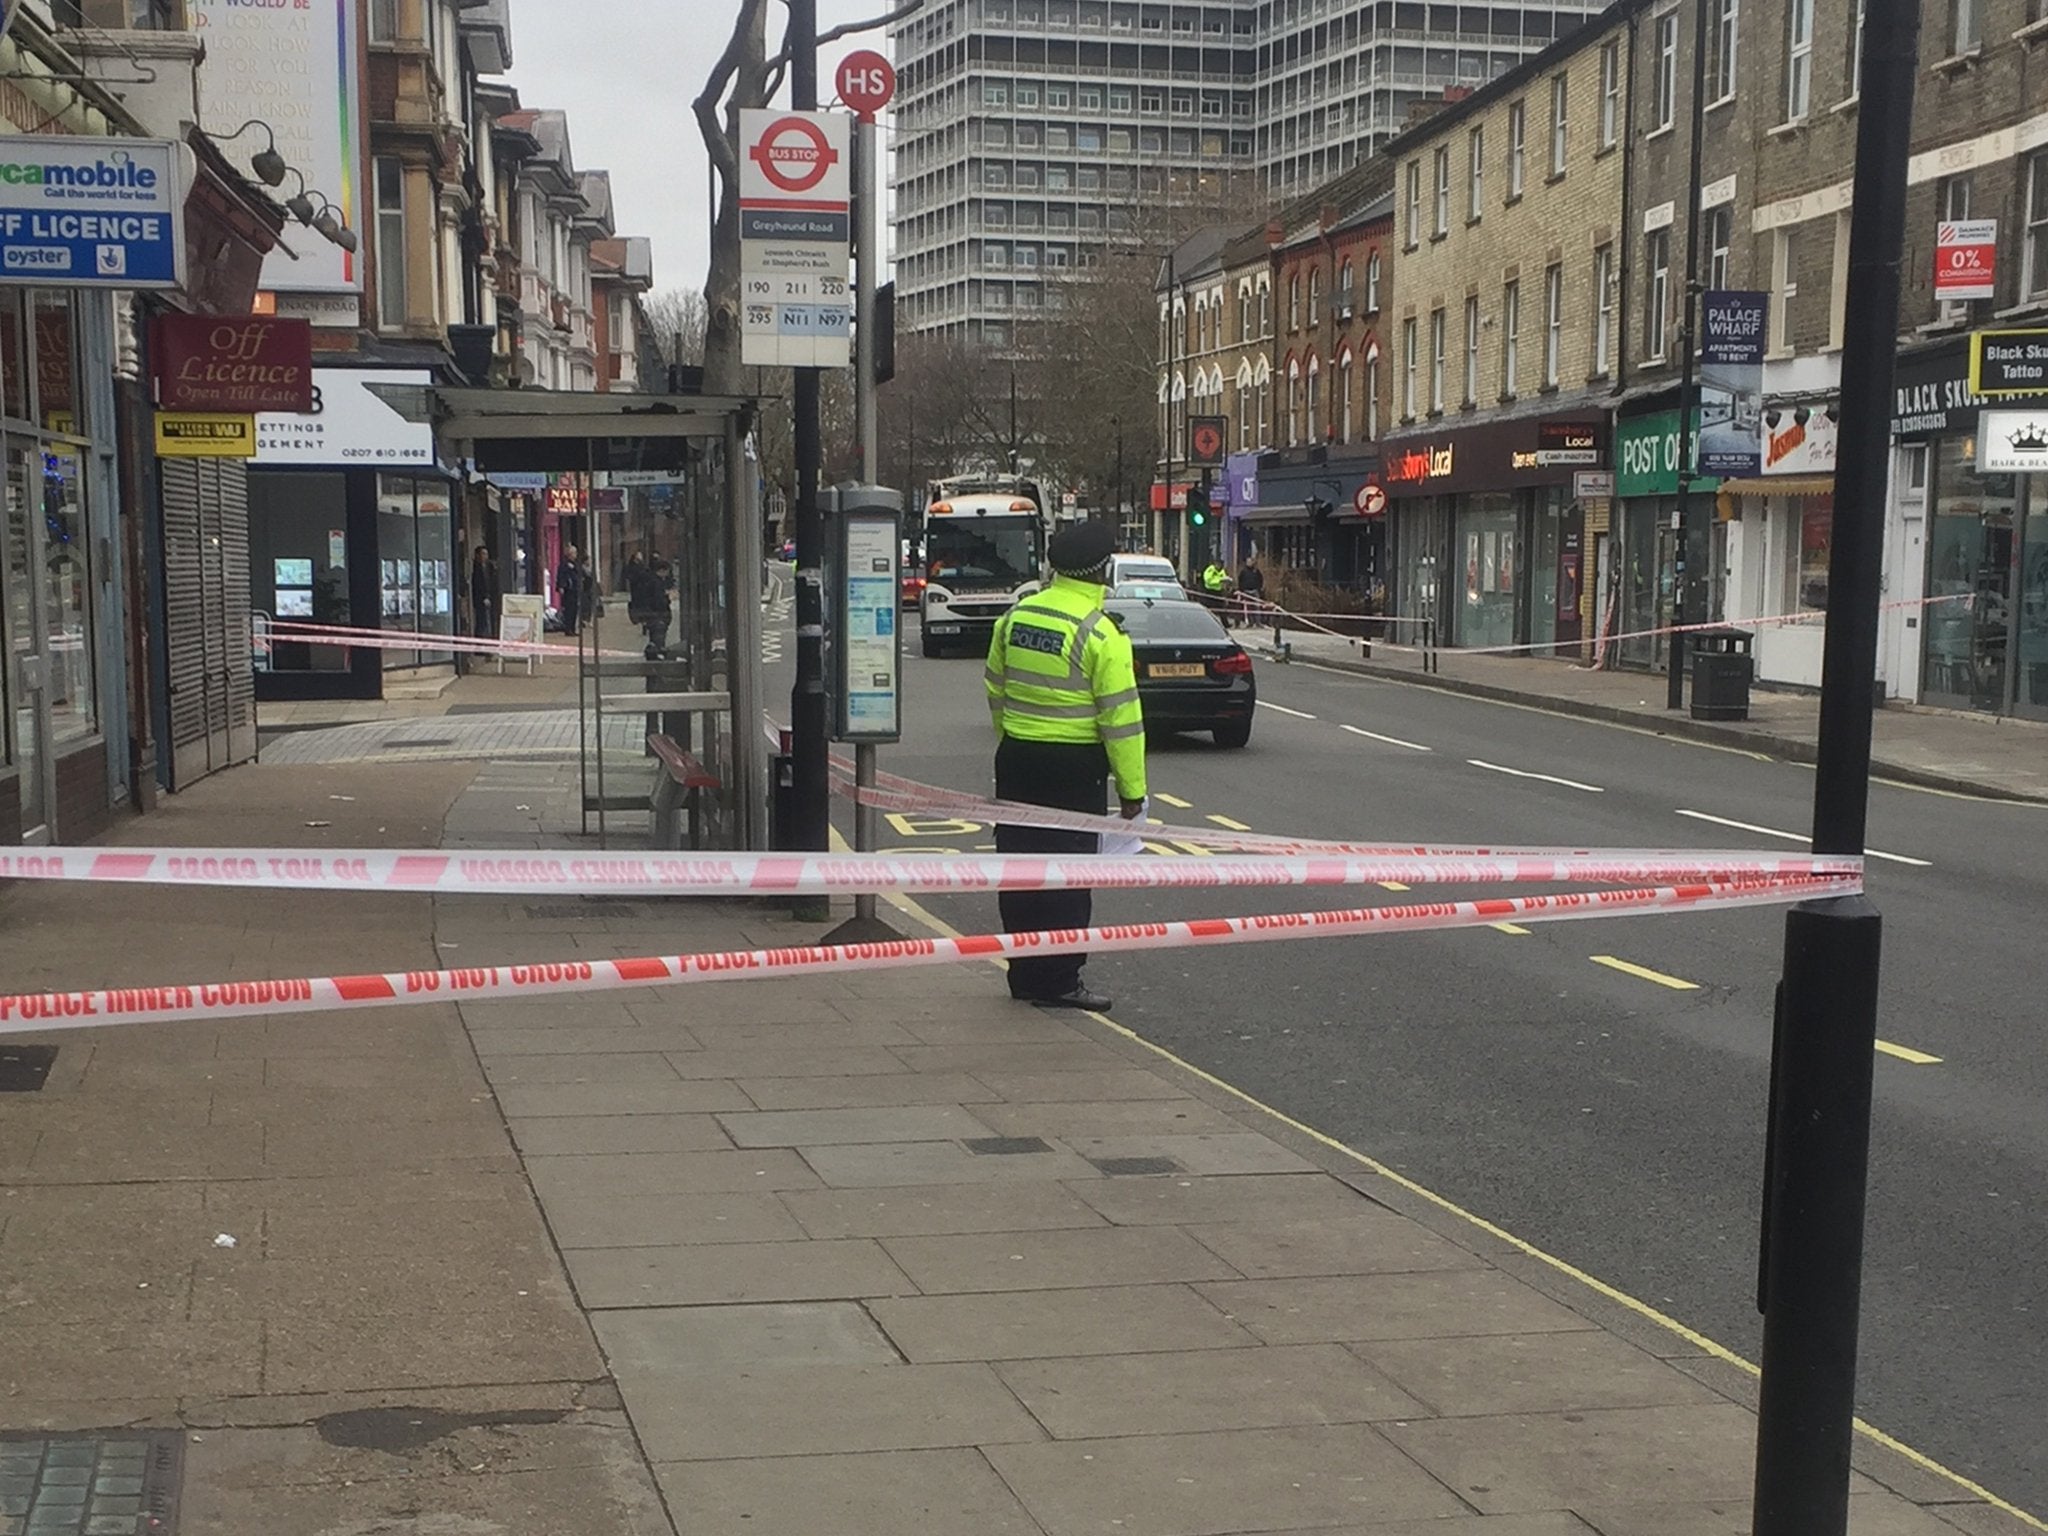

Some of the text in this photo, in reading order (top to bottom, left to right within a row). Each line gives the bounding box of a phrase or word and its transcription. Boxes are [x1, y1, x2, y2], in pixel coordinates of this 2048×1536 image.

[845, 68, 885, 96] HS
[768, 148, 820, 161] BUS STOP
[0, 158, 157, 189] camobile
[44, 187, 157, 201] Call the world for less
[32, 214, 161, 241] LICENCE
[752, 220, 834, 233] Greyhound Road
[7, 247, 64, 267] oyster
[1951, 249, 1981, 269] 0%
[748, 281, 844, 295] 190 211 220
[748, 312, 845, 326] 295 N11 N97
[1708, 308, 1762, 323] PALACE
[1708, 322, 1761, 336] WHARF
[209, 323, 275, 360] Off
[1708, 344, 1758, 353] APARTMENTS
[1728, 353, 1749, 362] RENT
[1987, 345, 2024, 361] Black
[177, 356, 299, 384] Licence
[2002, 364, 2044, 379] Tattoo
[176, 383, 220, 402] Open
[225, 384, 258, 400] Till
[260, 388, 300, 402] Late
[1897, 383, 1939, 415] BLACK
[1565, 436, 1594, 448] Local
[342, 449, 372, 458] 0207
[376, 449, 397, 458] 610
[1429, 441, 1454, 477] Local
[1564, 451, 1594, 461] machine
[1623, 434, 1660, 476] POST
[1011, 630, 1062, 655] POLICE
[679, 938, 935, 973] POLICE INNER CORDON
[406, 961, 593, 993] DO NOT CROSS
[1, 978, 312, 1021] POLICE INNER CORDON
